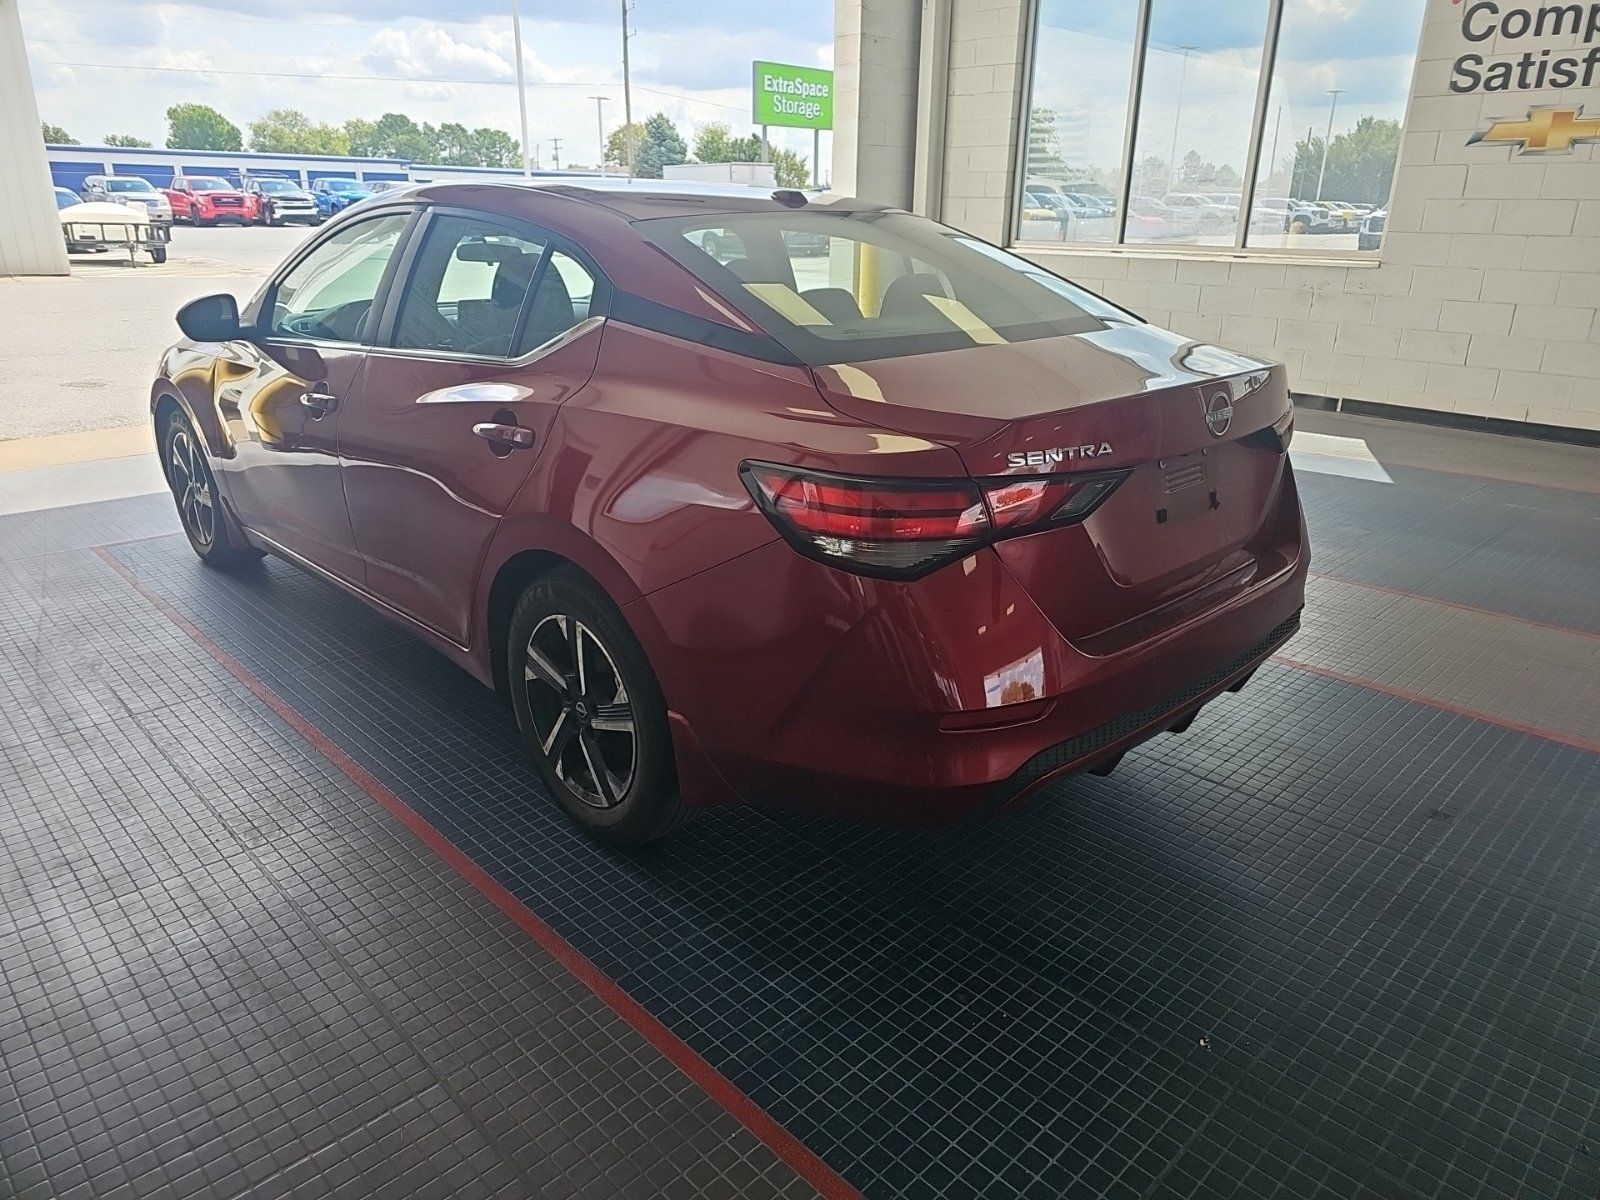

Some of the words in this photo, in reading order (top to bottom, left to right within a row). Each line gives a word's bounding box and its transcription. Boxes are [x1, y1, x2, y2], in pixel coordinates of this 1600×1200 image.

[1450, 47, 1600, 93] Satisf
[764, 74, 829, 98] ExtraSpace
[1007, 442, 1113, 467] SENTRA
